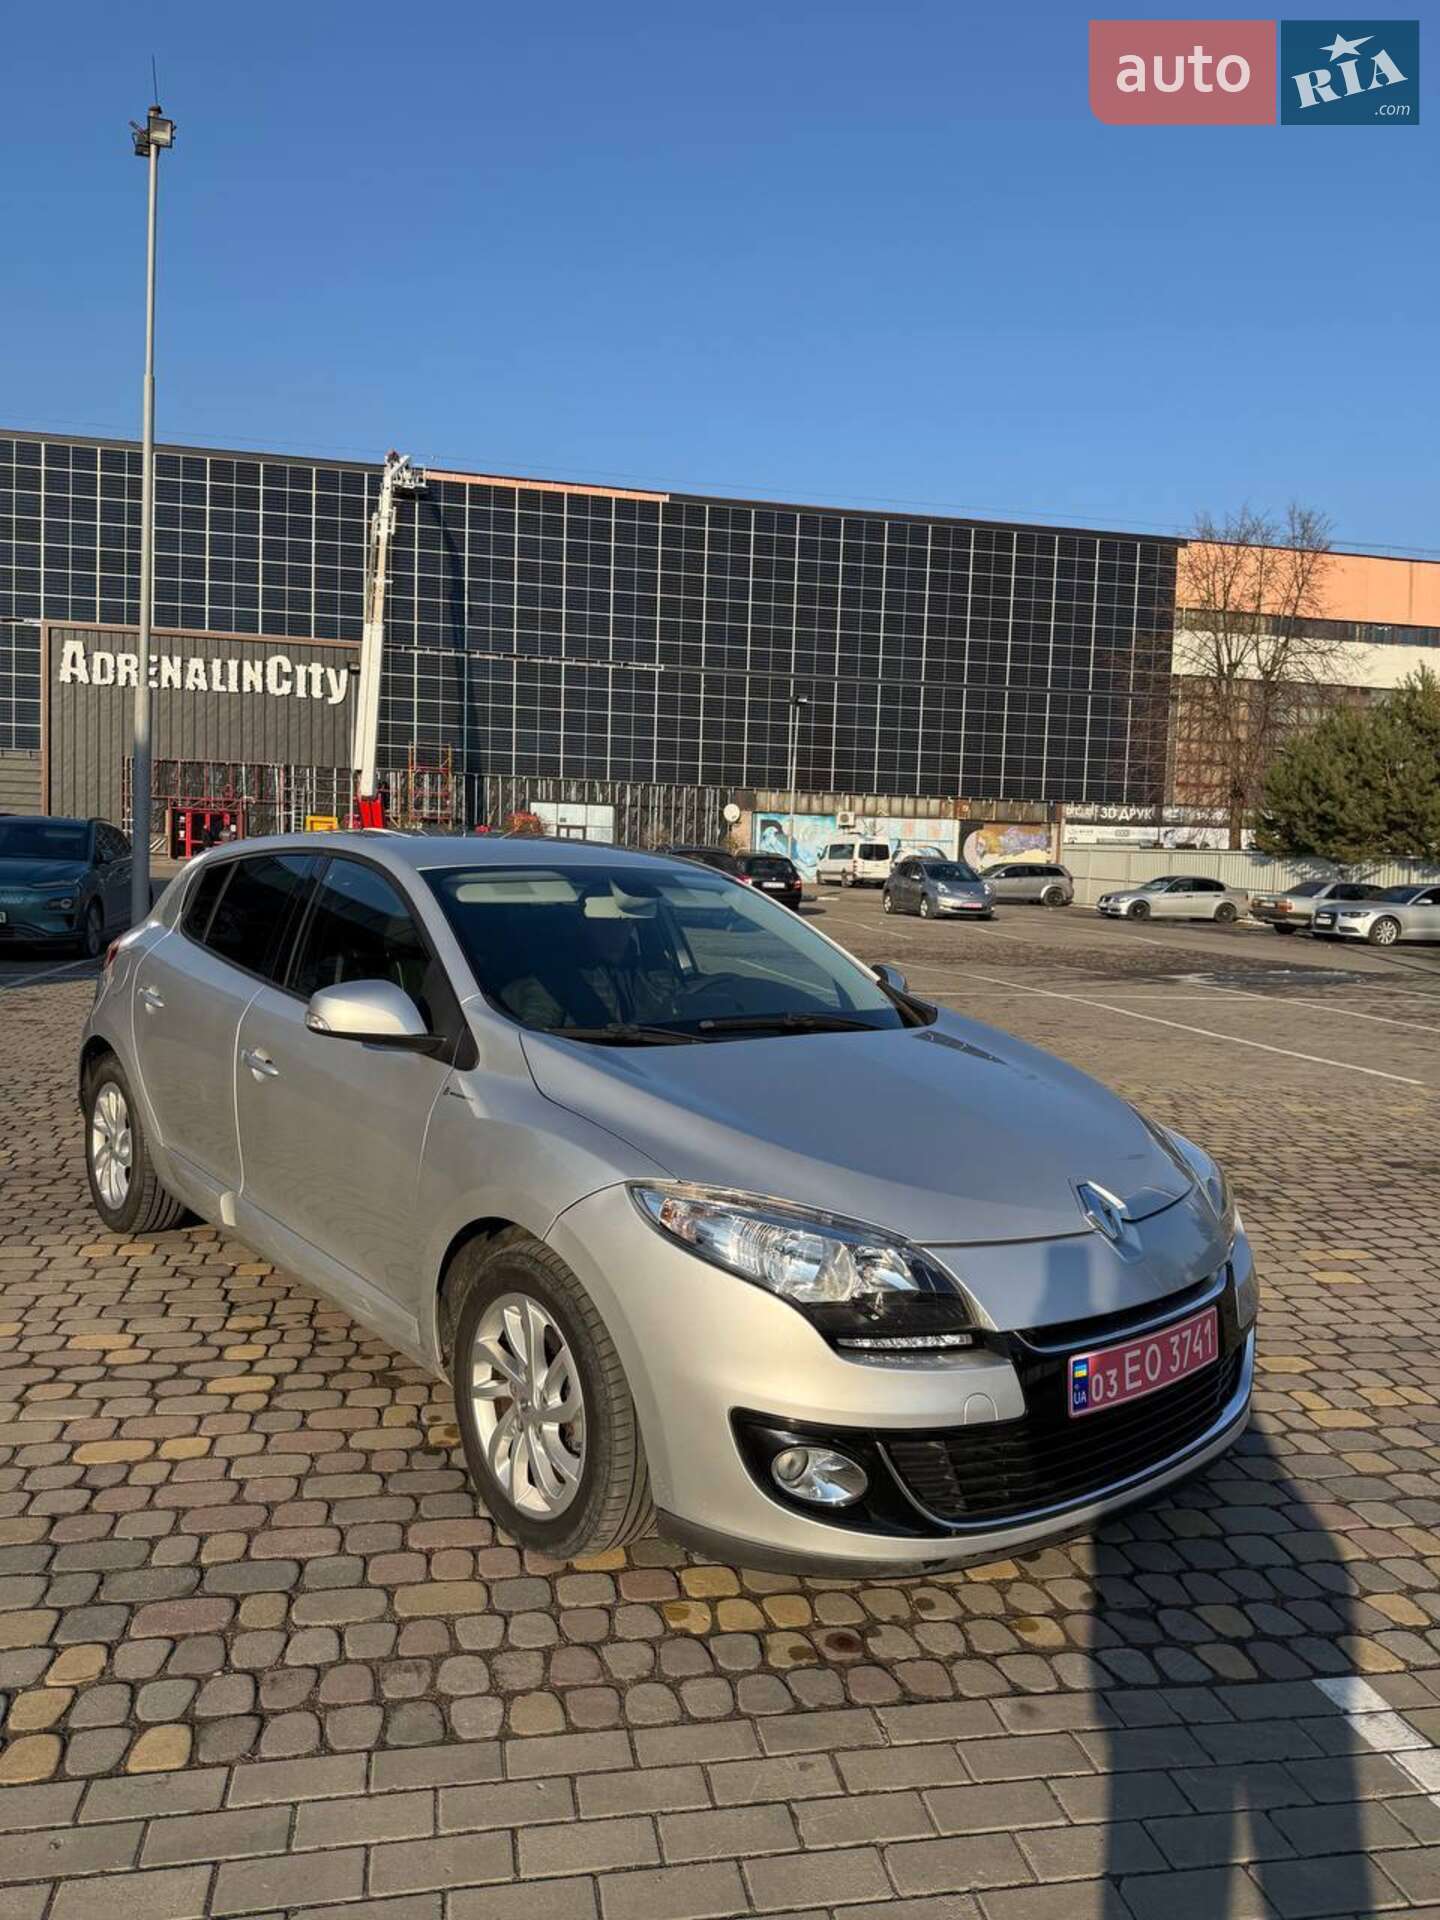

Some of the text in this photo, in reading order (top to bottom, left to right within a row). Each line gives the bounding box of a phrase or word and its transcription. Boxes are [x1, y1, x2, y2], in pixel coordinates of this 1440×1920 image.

[1091, 1318, 1213, 1402] 03 EO 3741
[1073, 1391, 1087, 1405] UA
